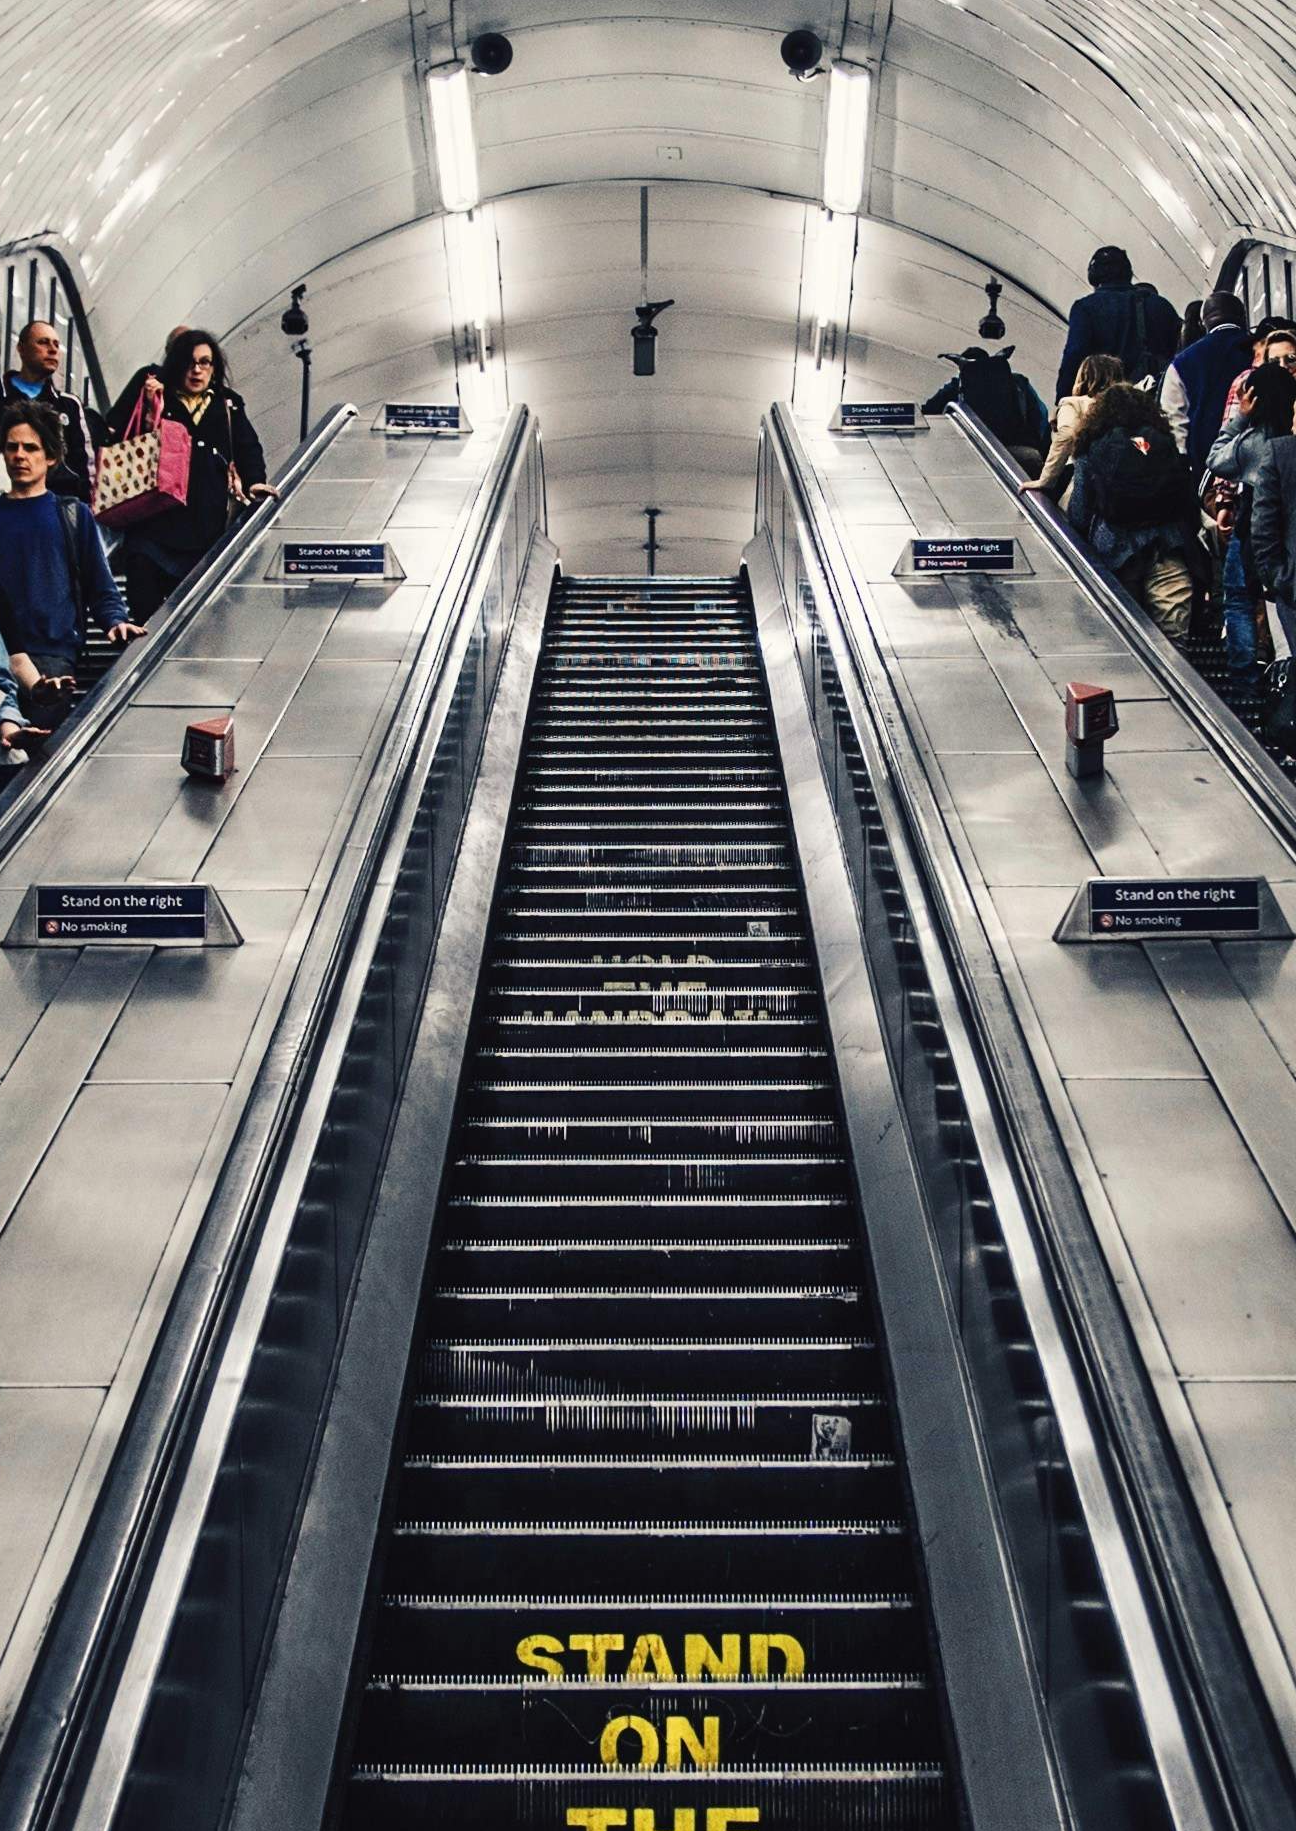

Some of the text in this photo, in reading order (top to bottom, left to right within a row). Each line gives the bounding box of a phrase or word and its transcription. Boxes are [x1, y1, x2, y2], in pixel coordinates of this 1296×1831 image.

[298, 548, 323, 556] Stand
[335, 548, 350, 556] the
[352, 548, 372, 557] right
[927, 544, 951, 553] Stand
[964, 544, 979, 552] the
[980, 544, 1000, 554] right
[62, 894, 183, 910] Stand on the right
[1115, 888, 1236, 903] Stand on the right
[61, 921, 128, 934] No smoking
[1115, 915, 1182, 927] No smoking
[515, 1633, 806, 1681] STAND
[600, 1715, 720, 1771] ON
